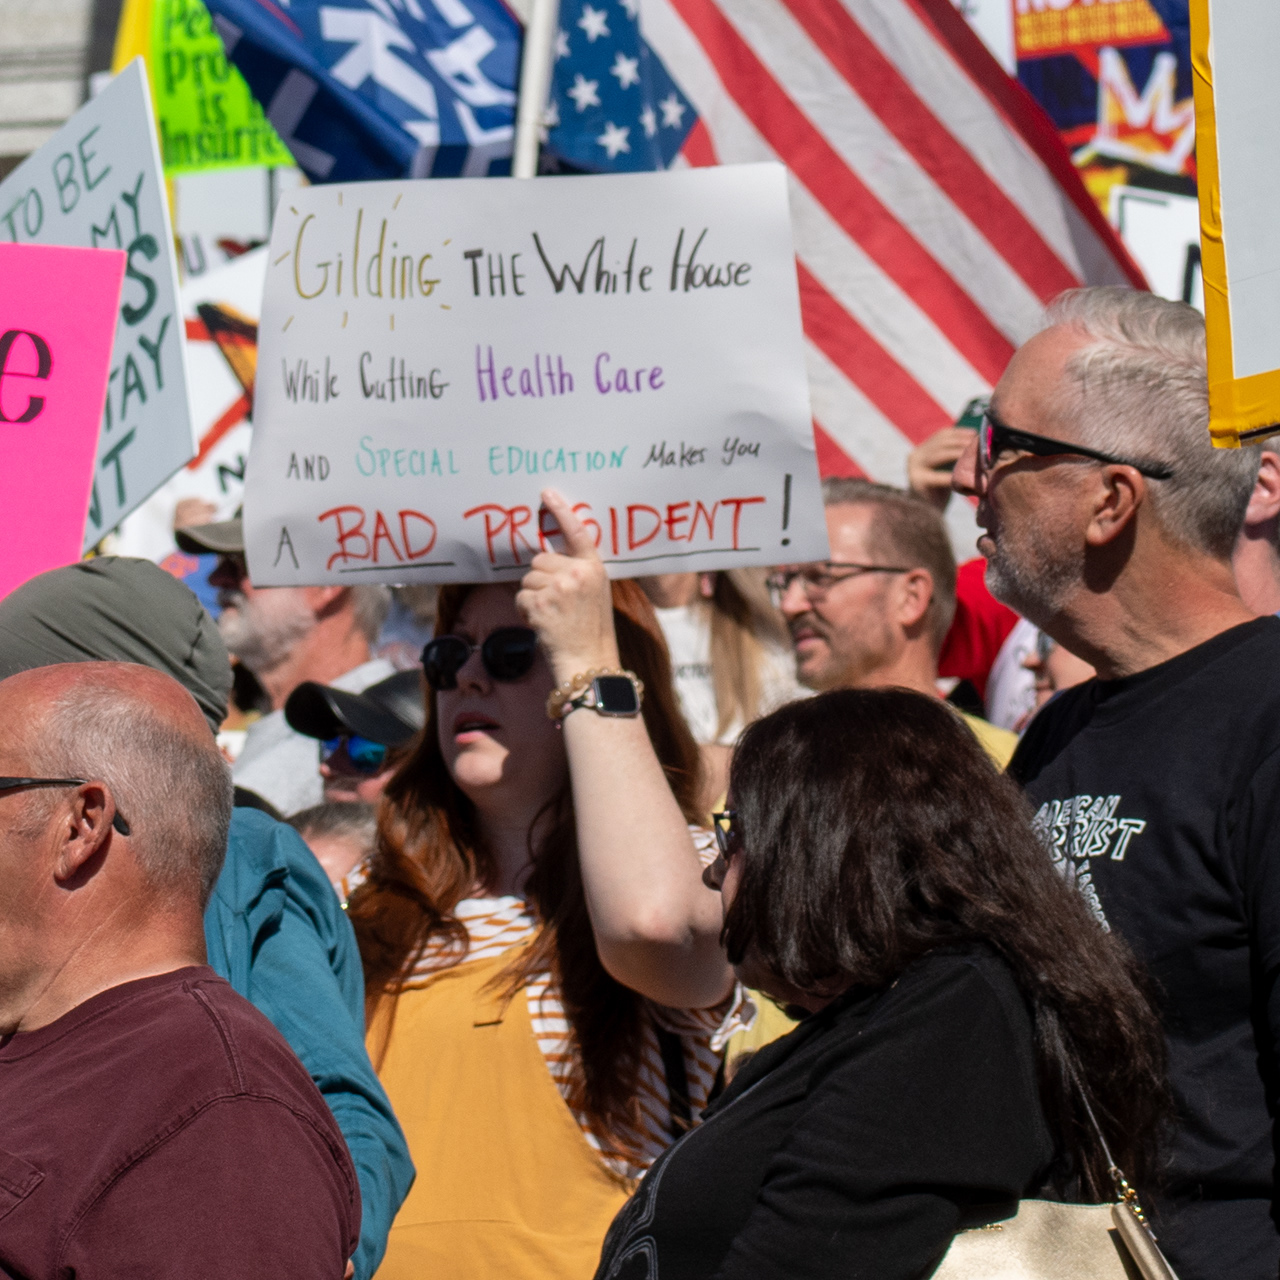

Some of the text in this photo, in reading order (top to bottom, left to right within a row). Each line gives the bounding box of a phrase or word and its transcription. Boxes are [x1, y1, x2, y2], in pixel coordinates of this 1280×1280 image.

[51, 126, 112, 215] BE
[464, 248, 526, 297] THE
[532, 231, 653, 295] White
[670, 228, 752, 292] House
[282, 344, 665, 404] While Cutting Health Care
[287, 452, 330, 481] AND
[355, 436, 461, 477] SPECIAL
[489, 445, 629, 475] EDUCATION
[643, 440, 706, 469] Makes
[274, 527, 299, 569] A
[318, 506, 438, 571] BAD
